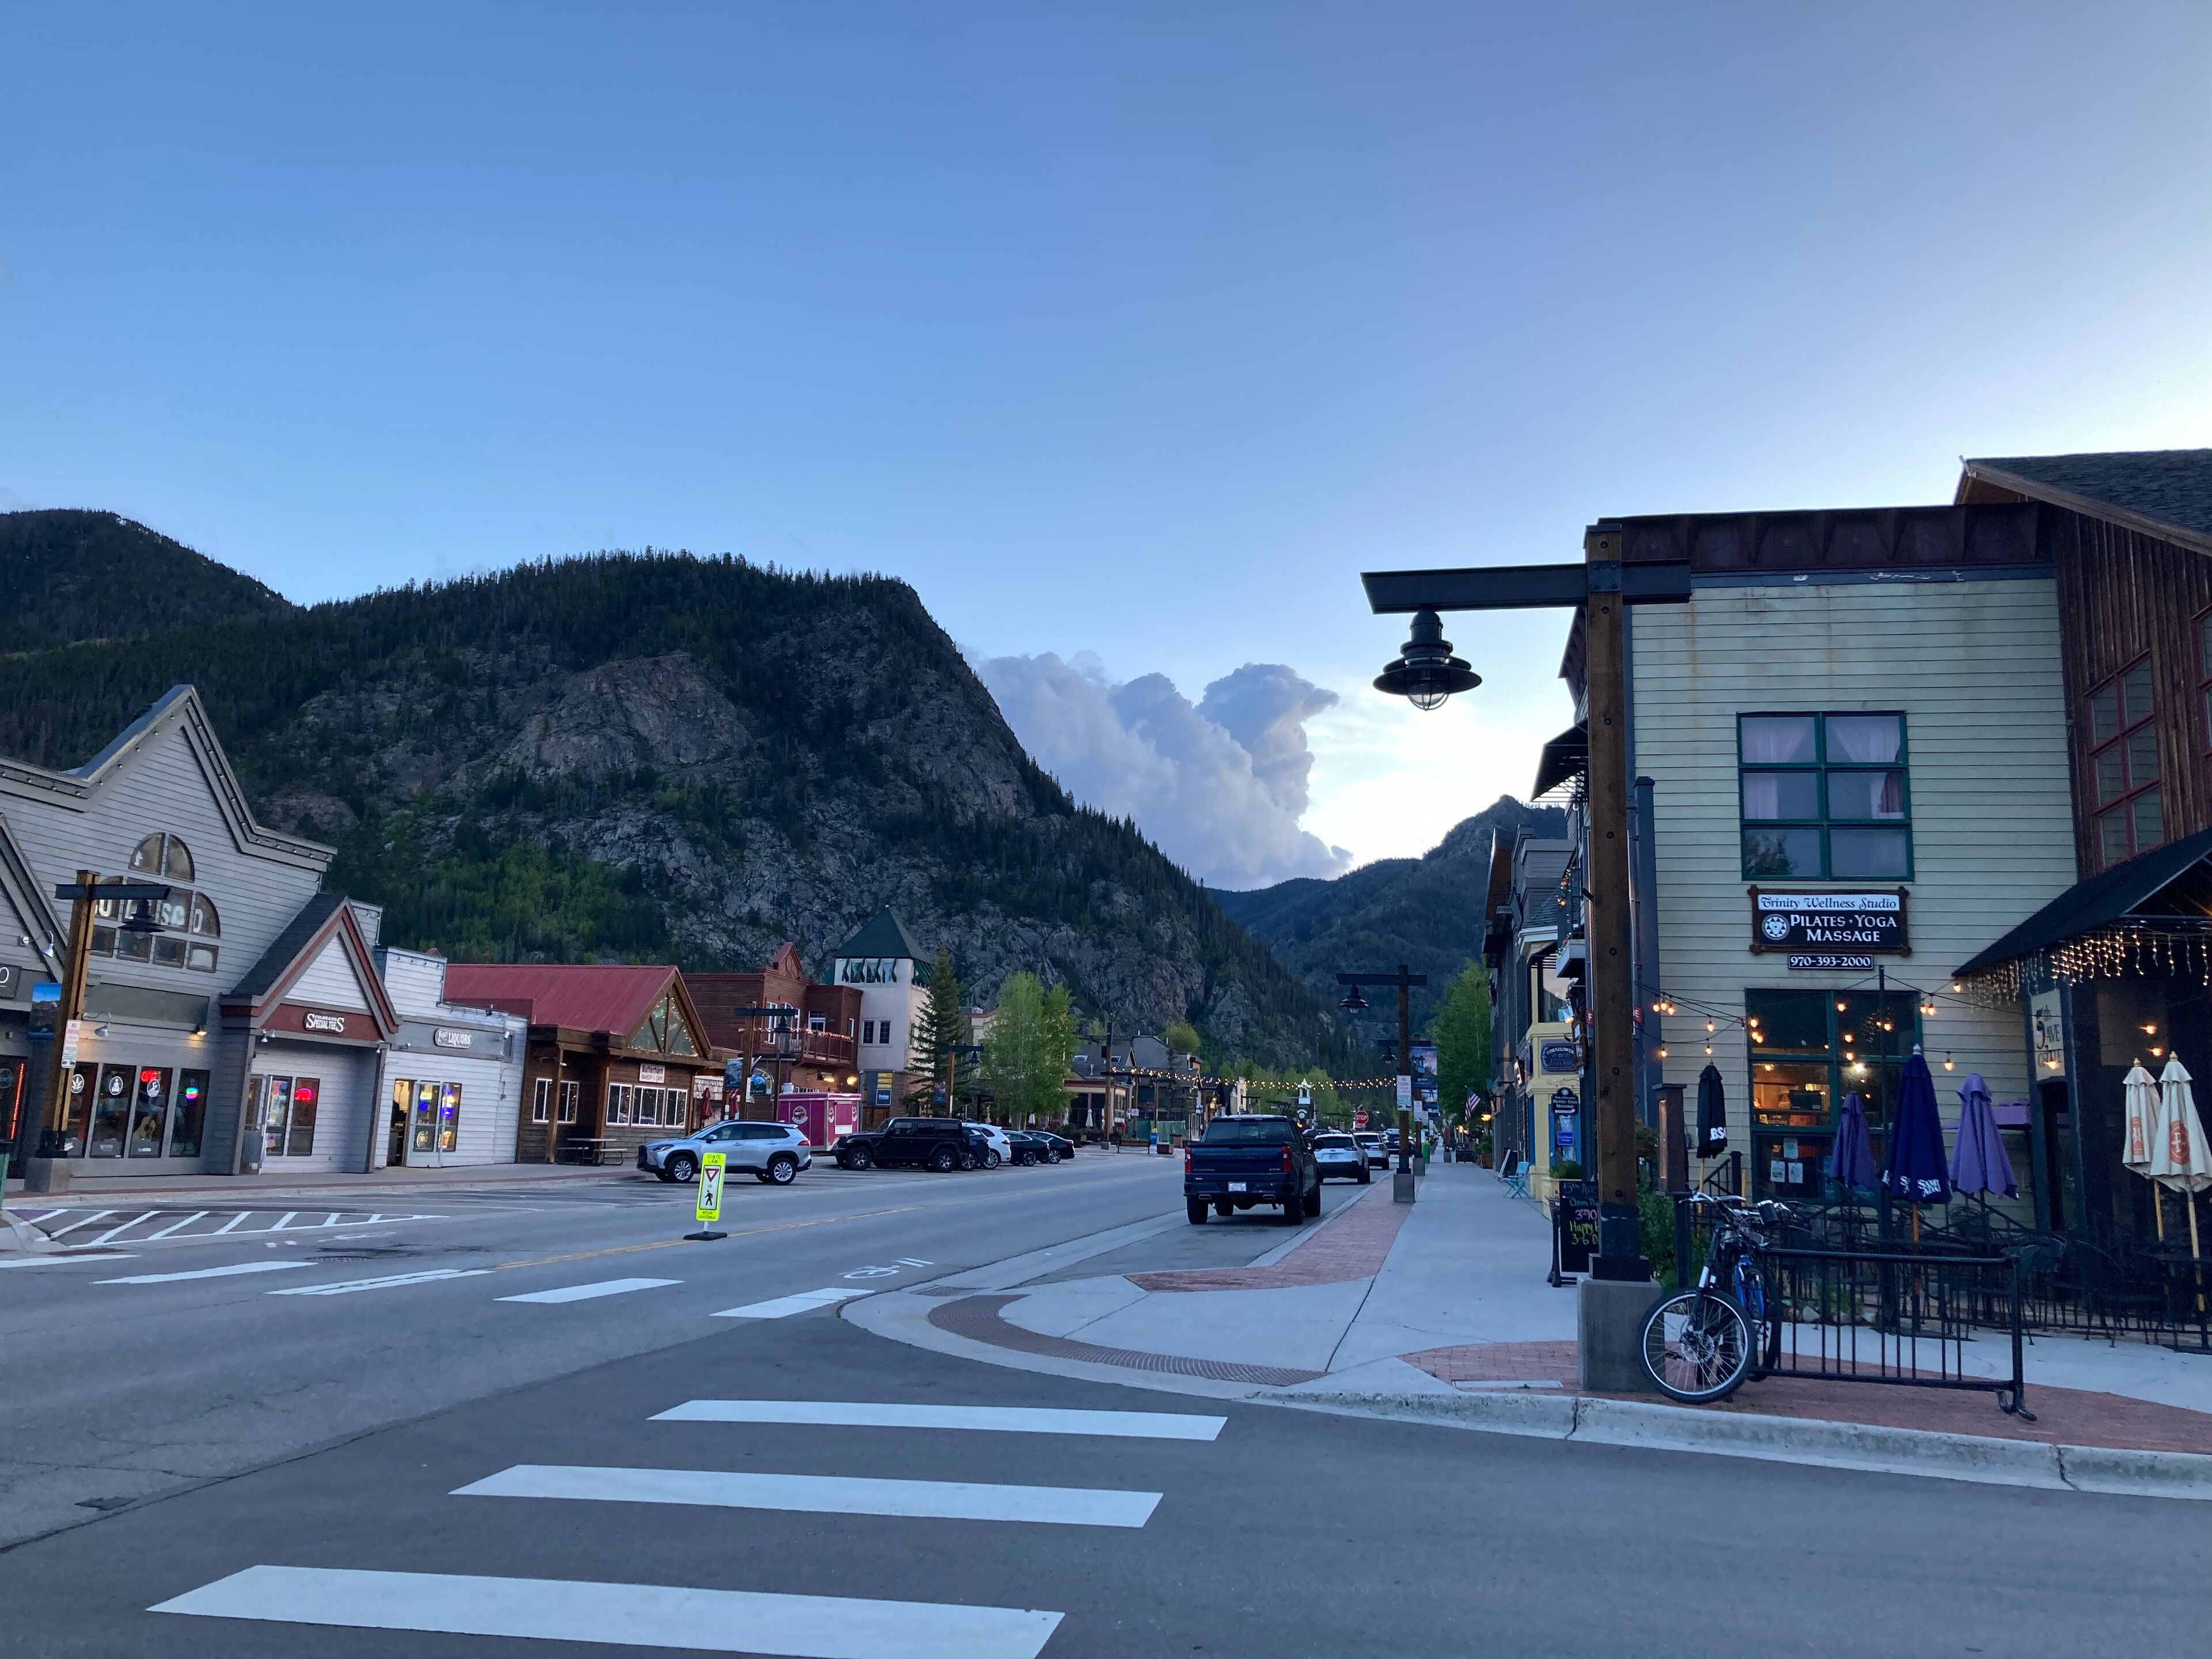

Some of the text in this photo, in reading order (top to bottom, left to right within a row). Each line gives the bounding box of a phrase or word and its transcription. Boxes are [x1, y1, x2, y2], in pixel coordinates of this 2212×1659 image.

[1760, 896, 1896, 910] Trinity Wellness Studio
[1790, 914, 1897, 927] PILATES YOGA
[1806, 929, 1880, 942] MASSAGE
[1790, 956, 1871, 966] 970-393-2000
[448, 1032, 471, 1046] LIQUORS
[2047, 1024, 2061, 1043] AVE
[1569, 1220, 1593, 1235] Happy
